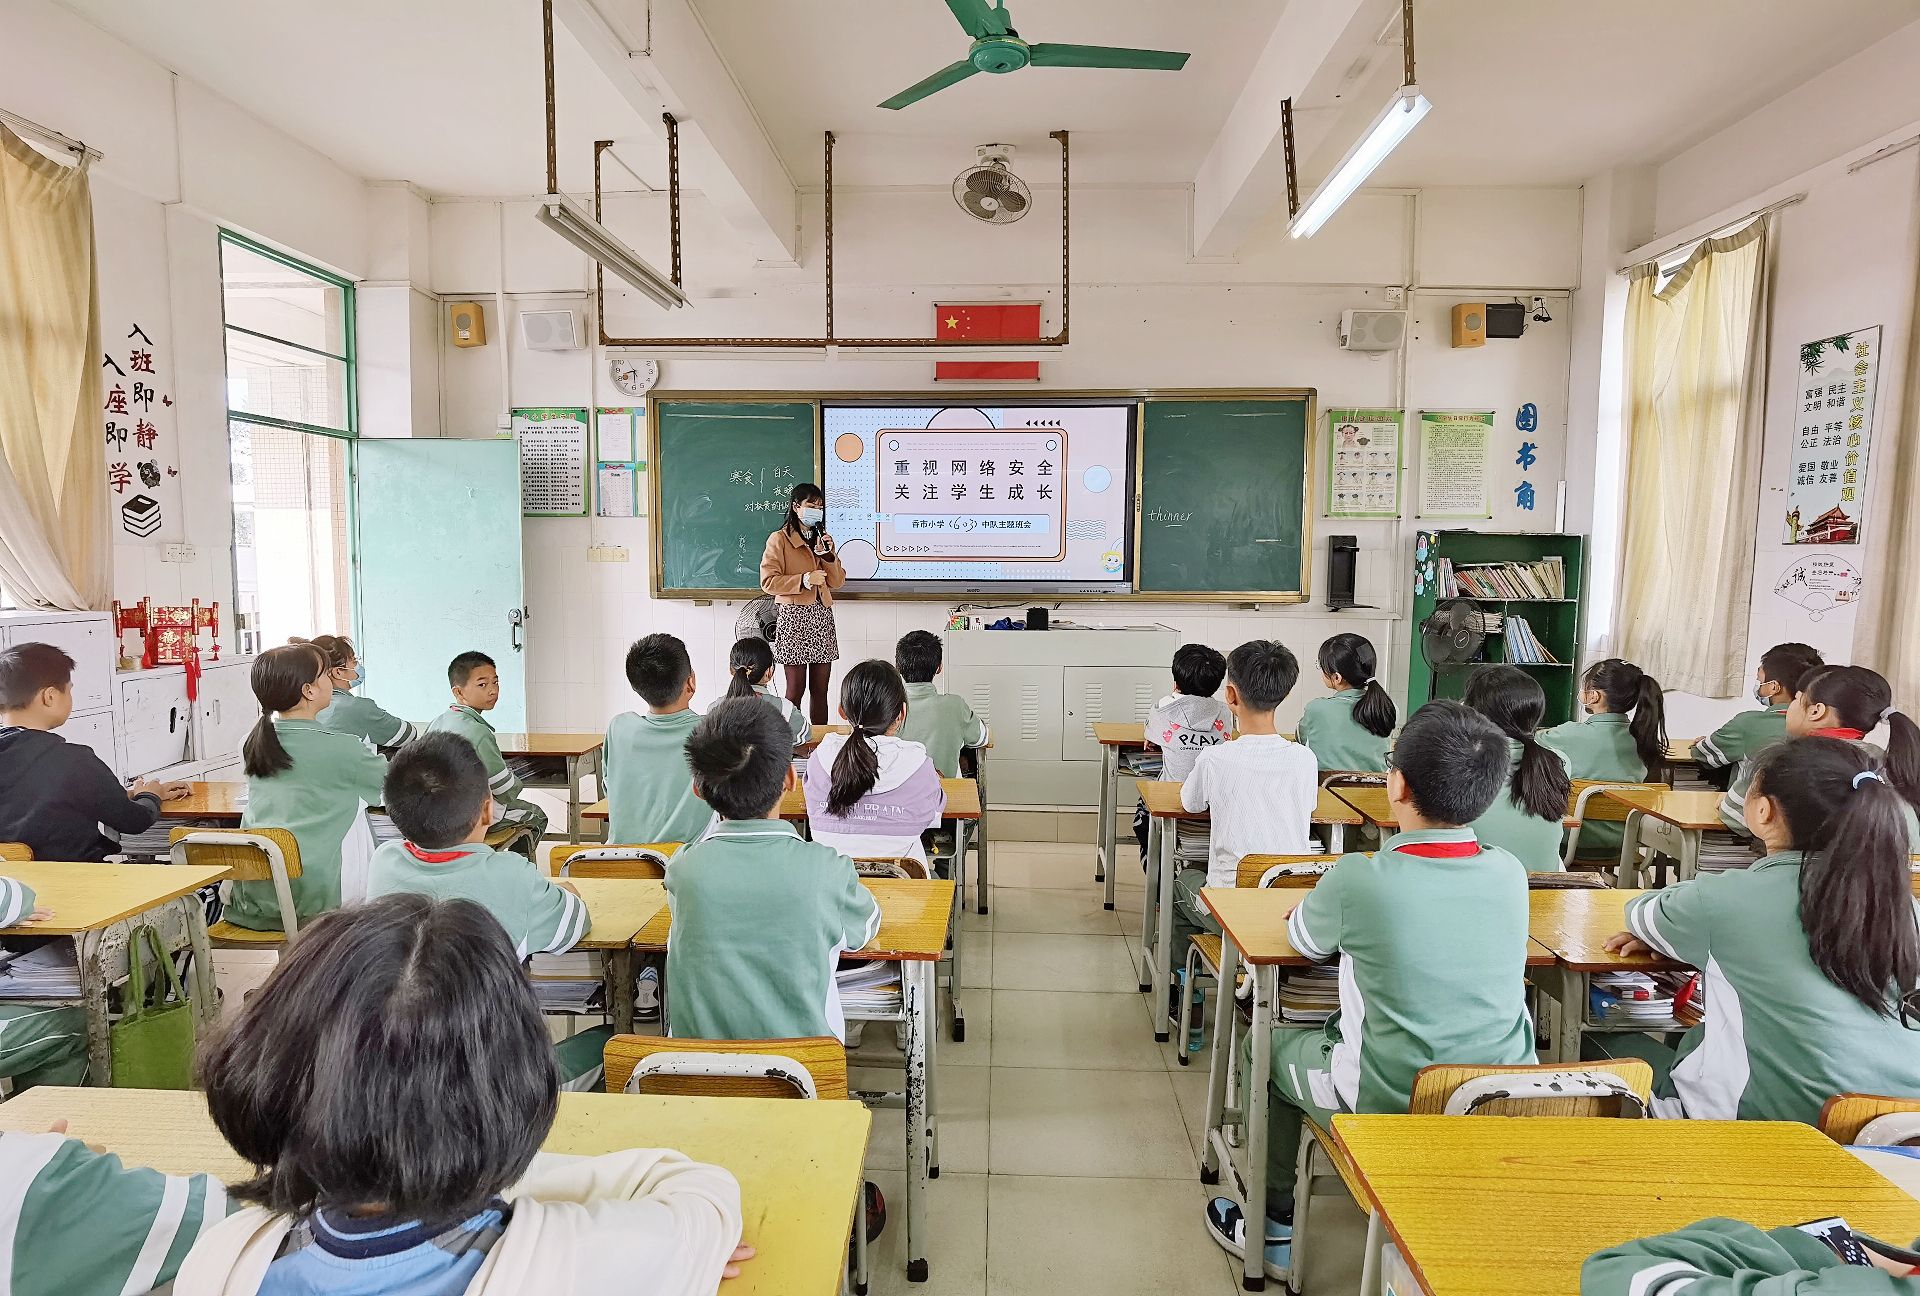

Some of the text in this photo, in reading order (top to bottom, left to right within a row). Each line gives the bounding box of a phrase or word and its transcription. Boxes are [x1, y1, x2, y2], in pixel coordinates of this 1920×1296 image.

[128, 323, 158, 450] 入班即静
[1806, 383, 1846, 399] 富强 民主
[1804, 396, 1845, 412] 文明 和谐
[103, 353, 132, 494] 入座即学
[1802, 421, 1843, 436] 自由 平等
[1841, 341, 1870, 502] 社会主义核心价值观
[1800, 435, 1841, 448] 公正 法治
[1514, 402, 1538, 511] 图书角
[894, 459, 1053, 476] 重视网络安全
[1798, 460, 1838, 473] 爱国 敬业
[1797, 473, 1837, 485] 诚信 友善
[894, 484, 1053, 500] 关注学生成长
[1148, 506, 1193, 521] thinner
[1179, 733, 1220, 746] PLAY
